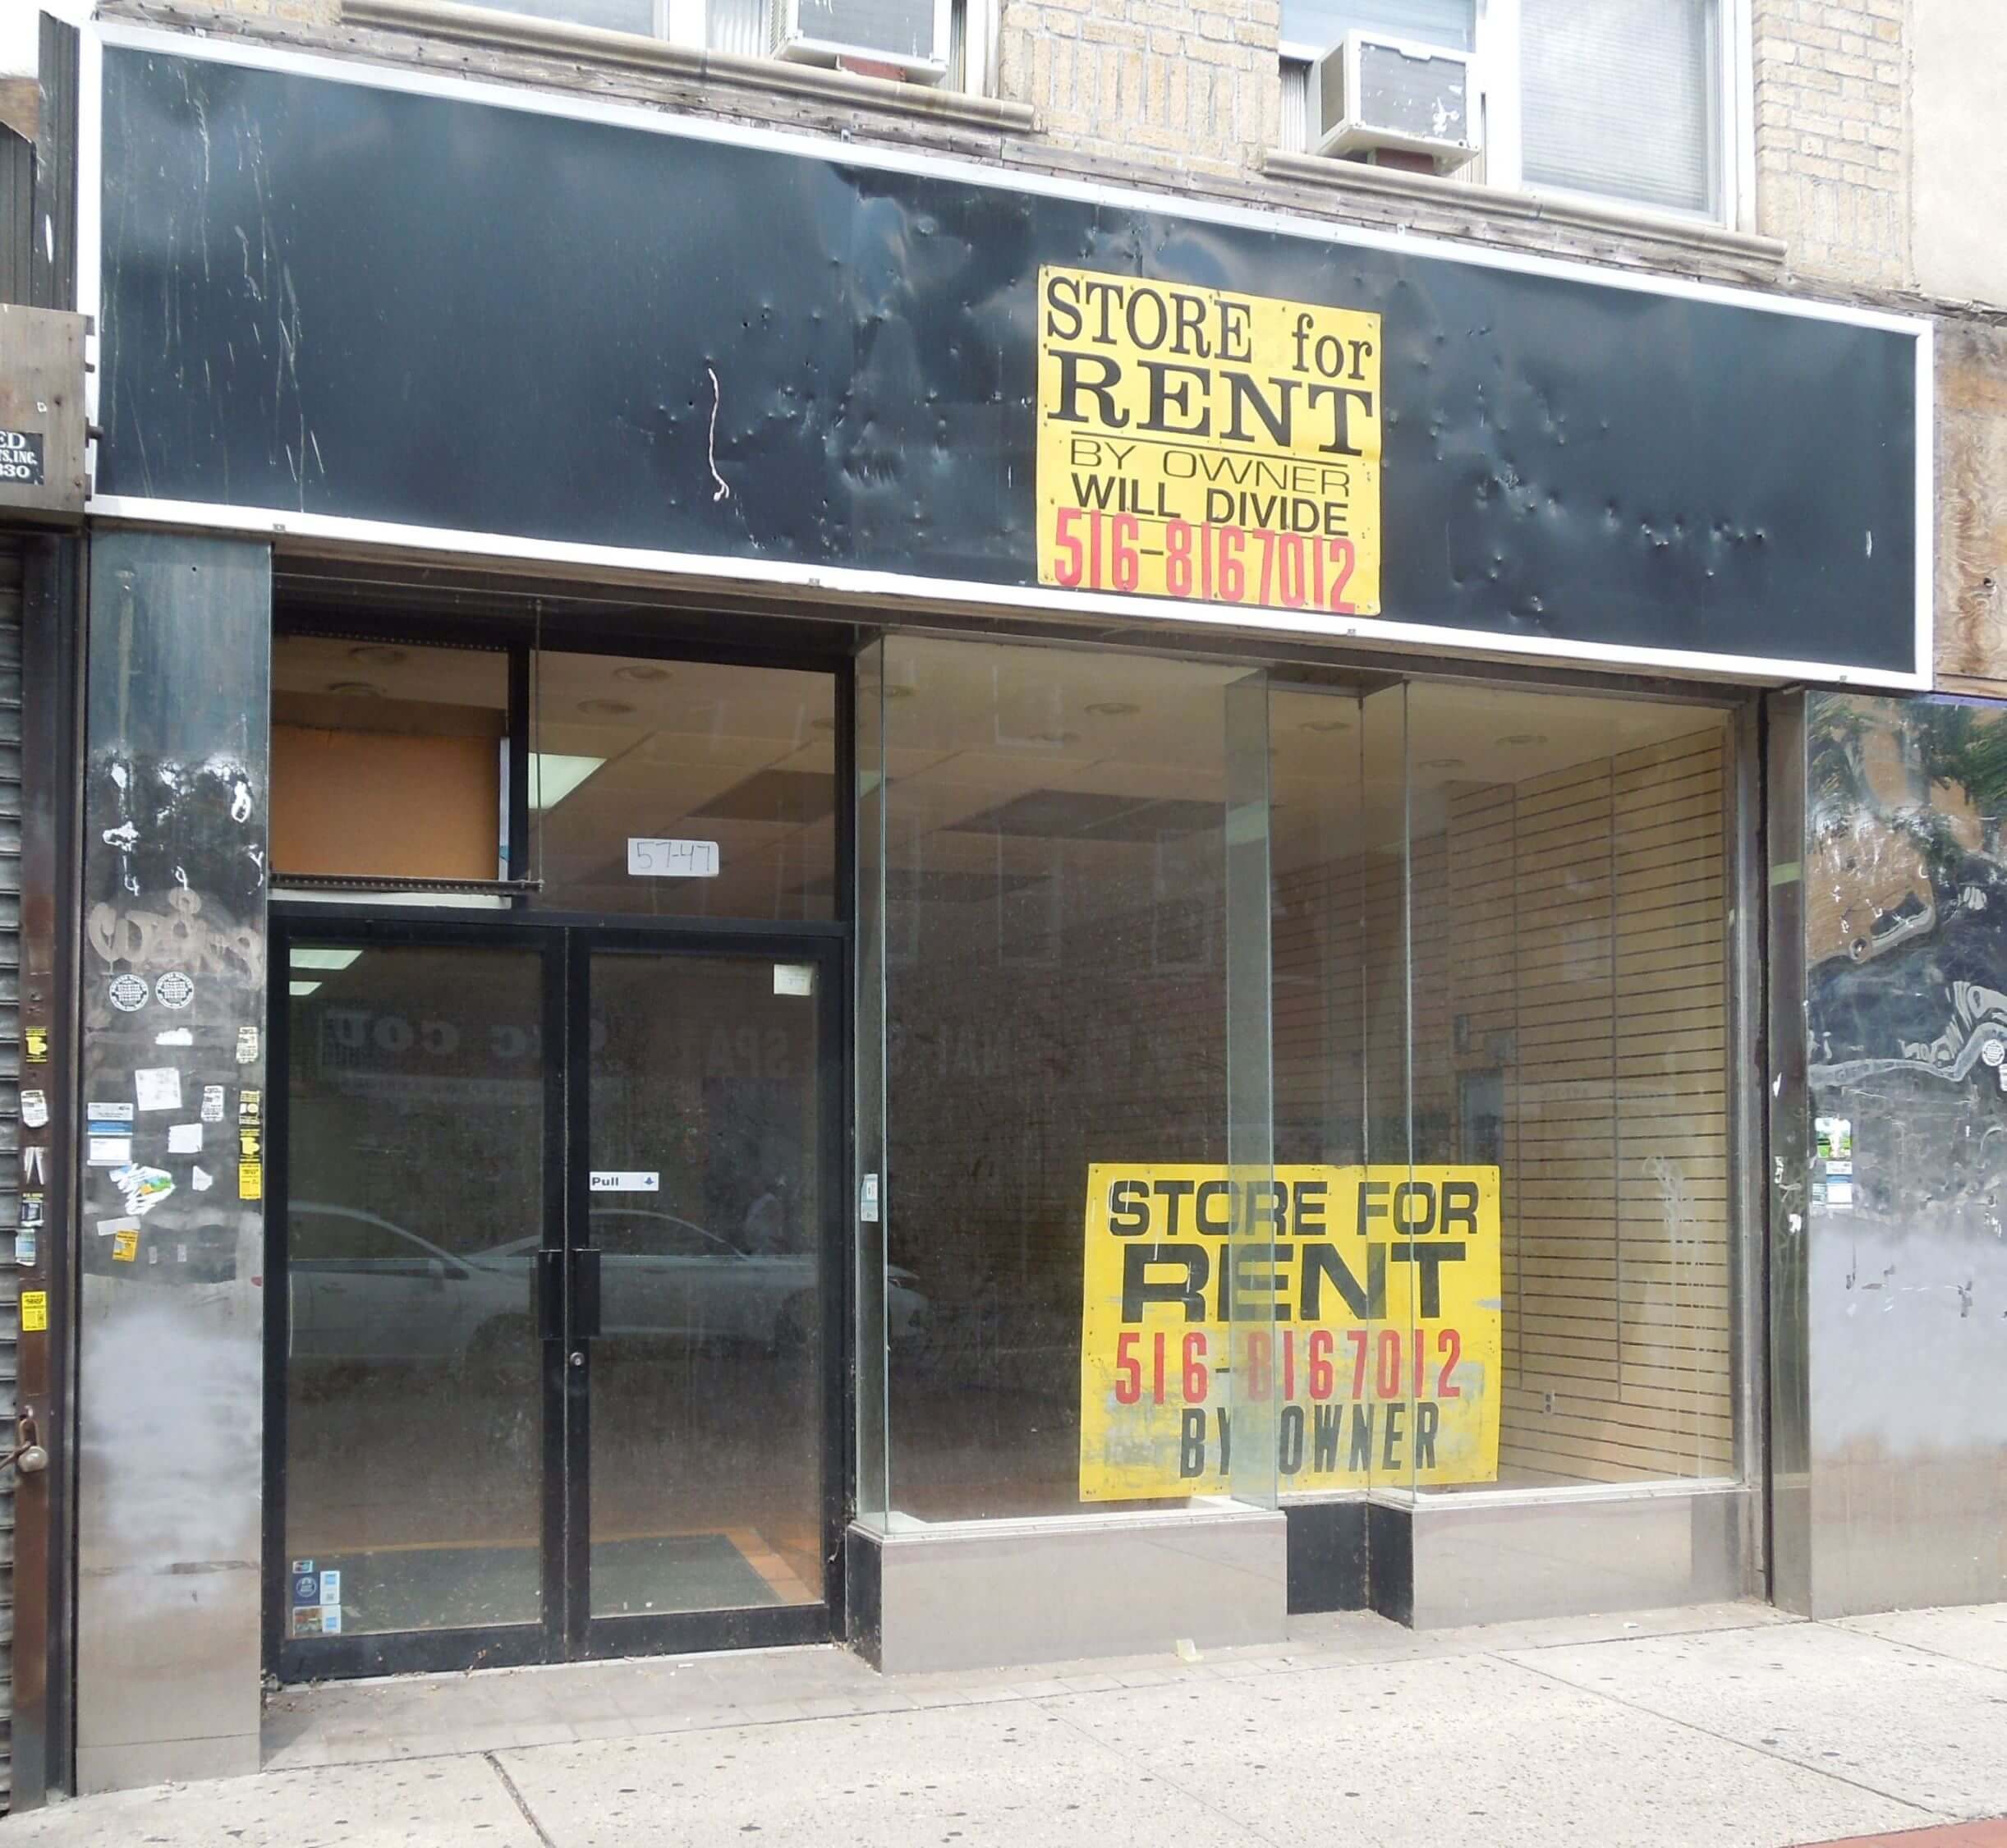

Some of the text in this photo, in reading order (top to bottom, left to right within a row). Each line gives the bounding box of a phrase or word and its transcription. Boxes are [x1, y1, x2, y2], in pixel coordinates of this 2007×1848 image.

[1046, 276, 1373, 381] STORE for
[1046, 348, 1373, 457] RENT
[1070, 438, 1351, 497] BY OWNER
[1071, 472, 1349, 537] WILL DIVIDE
[1054, 506, 1357, 615] 516-8167012
[591, 1176, 619, 1186] Pull
[1109, 1179, 1479, 1236] STORE FOR
[1122, 1241, 1467, 1323] RENT
[1279, 1401, 1440, 1476] OWNER
